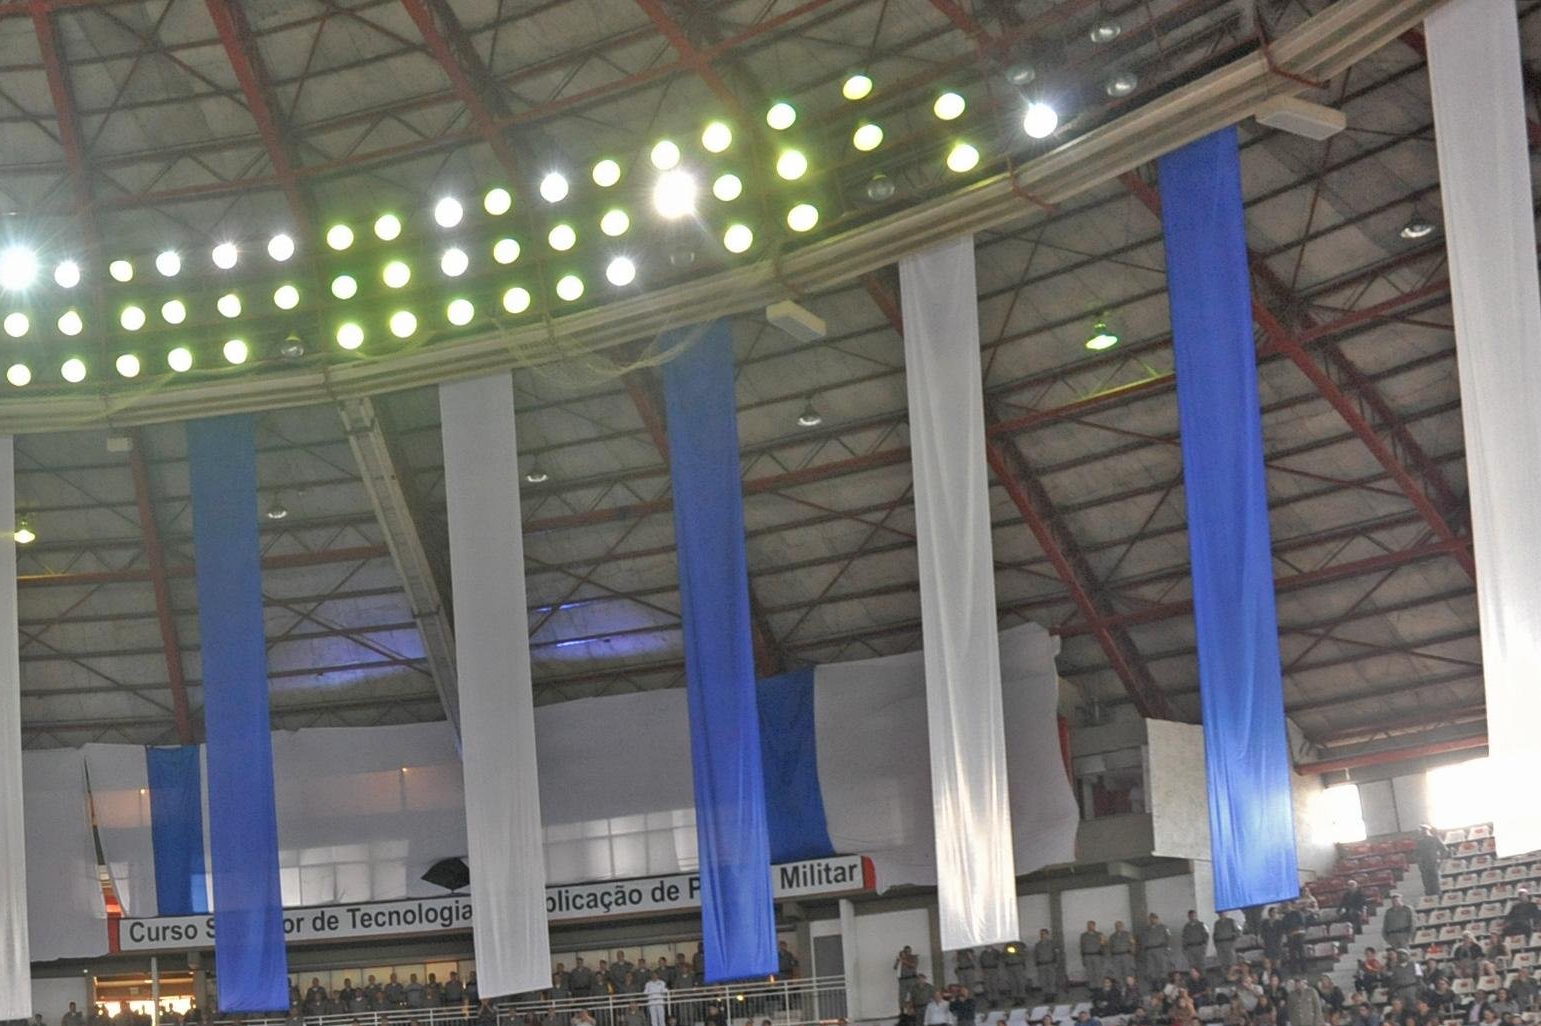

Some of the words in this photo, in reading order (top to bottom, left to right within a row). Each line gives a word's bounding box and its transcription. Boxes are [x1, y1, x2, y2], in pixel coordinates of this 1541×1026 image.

[129, 921, 198, 943] Curso
[312, 910, 339, 931] de
[346, 900, 472, 929] Tecnologia
[546, 884, 643, 914] plicação
[651, 880, 680, 903] de
[780, 863, 858, 890] Militar
